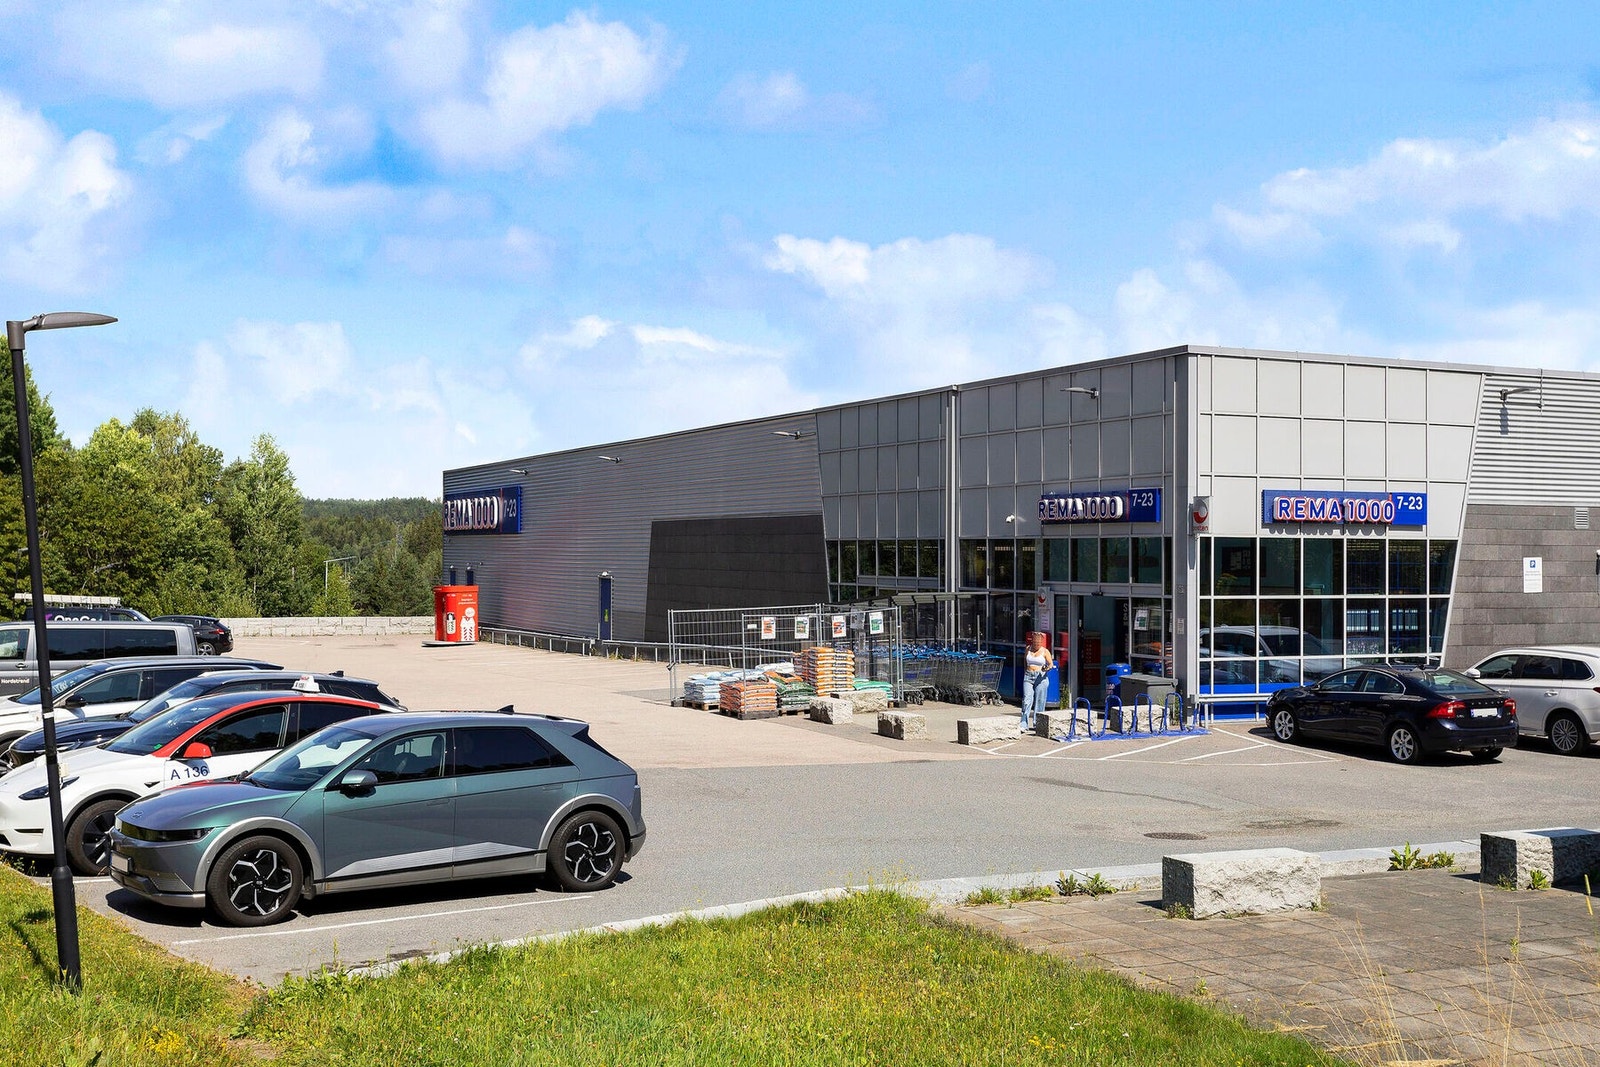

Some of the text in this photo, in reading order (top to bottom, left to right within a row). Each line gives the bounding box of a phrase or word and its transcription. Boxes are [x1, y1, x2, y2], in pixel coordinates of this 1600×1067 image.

[443, 497, 517, 530] REMA 1000 7-23
[1038, 492, 1154, 520] REMA 1000 7-23
[1276, 496, 1423, 521] REMA 1000 7-23
[170, 765, 209, 780] A 136
